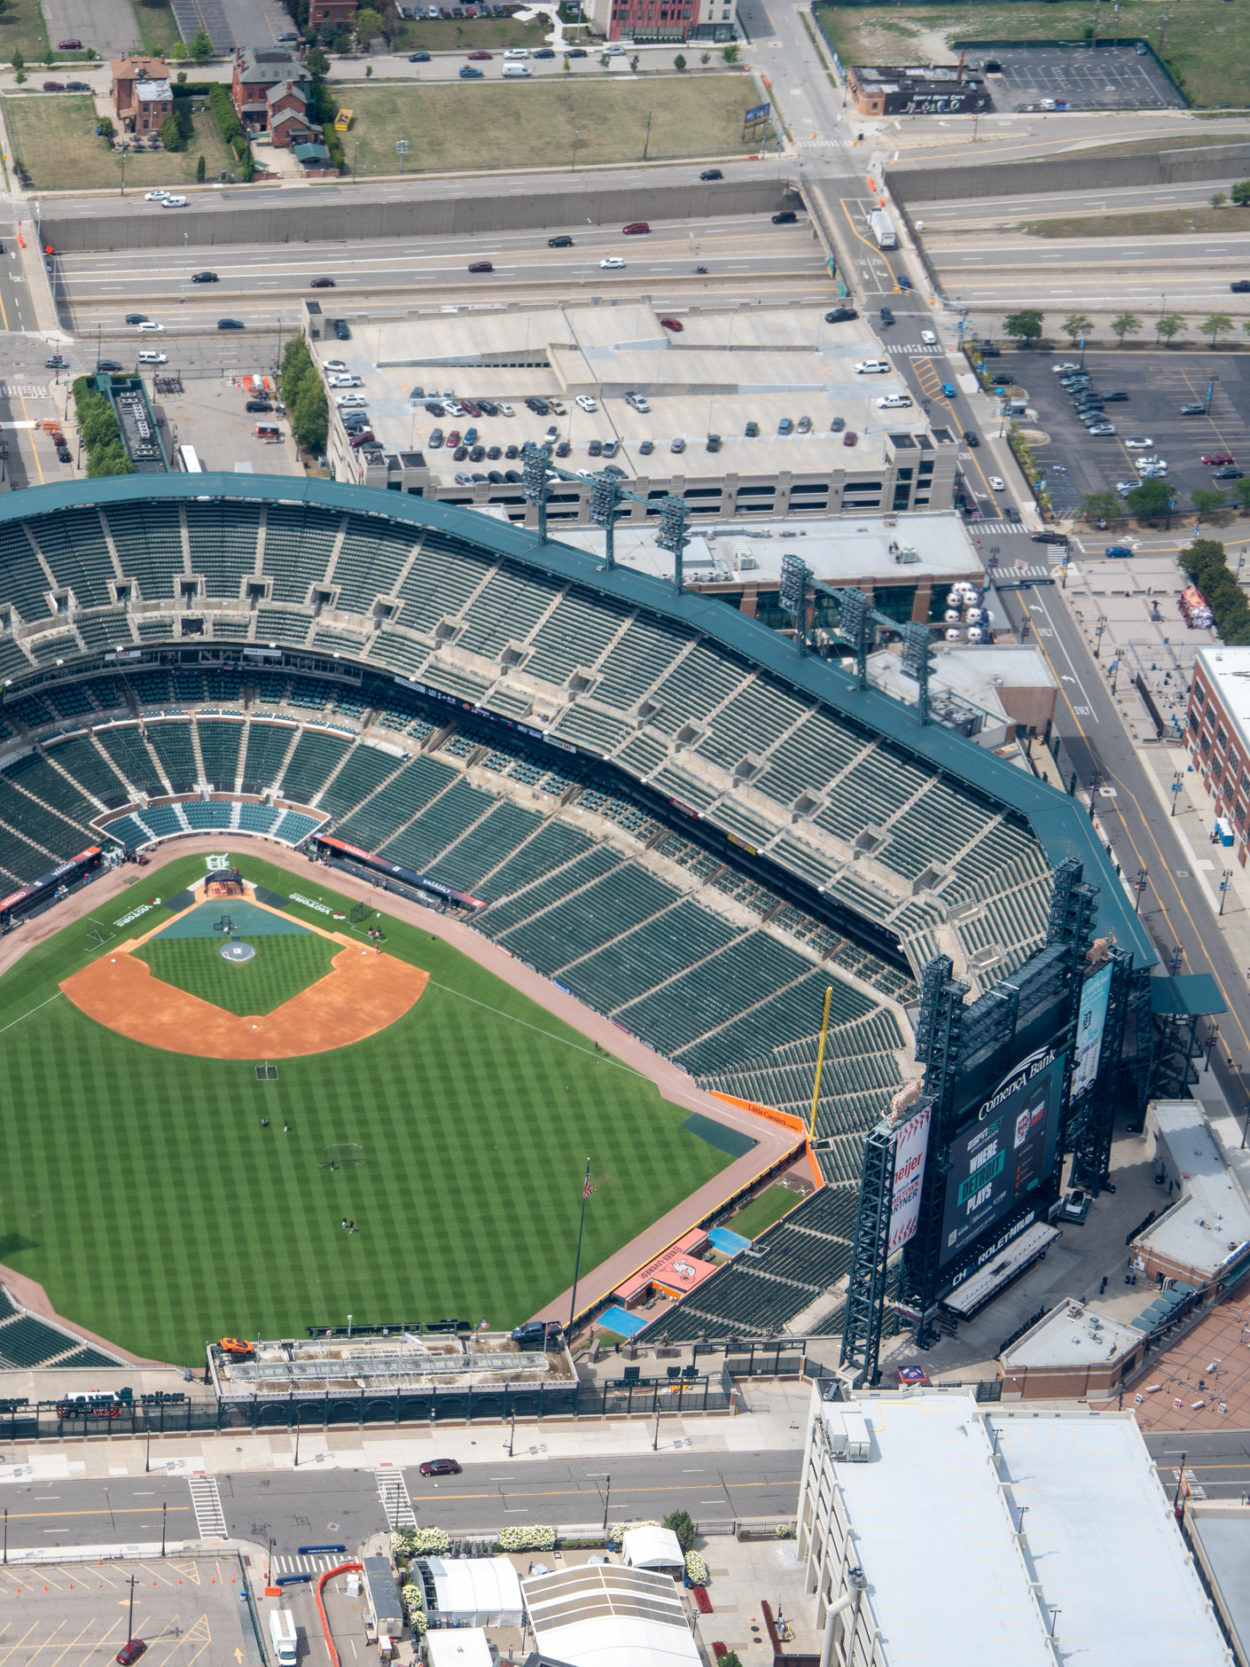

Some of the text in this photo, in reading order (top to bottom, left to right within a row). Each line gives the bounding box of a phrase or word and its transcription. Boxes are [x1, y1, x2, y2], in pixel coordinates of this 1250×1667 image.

[1074, 706, 1091, 715] ONLY
[116, 904, 154, 927] VICTORS
[969, 1139, 998, 1175] WHERE
[961, 1153, 1002, 1199] DETROIT
[966, 1182, 993, 1216] PLAYS
